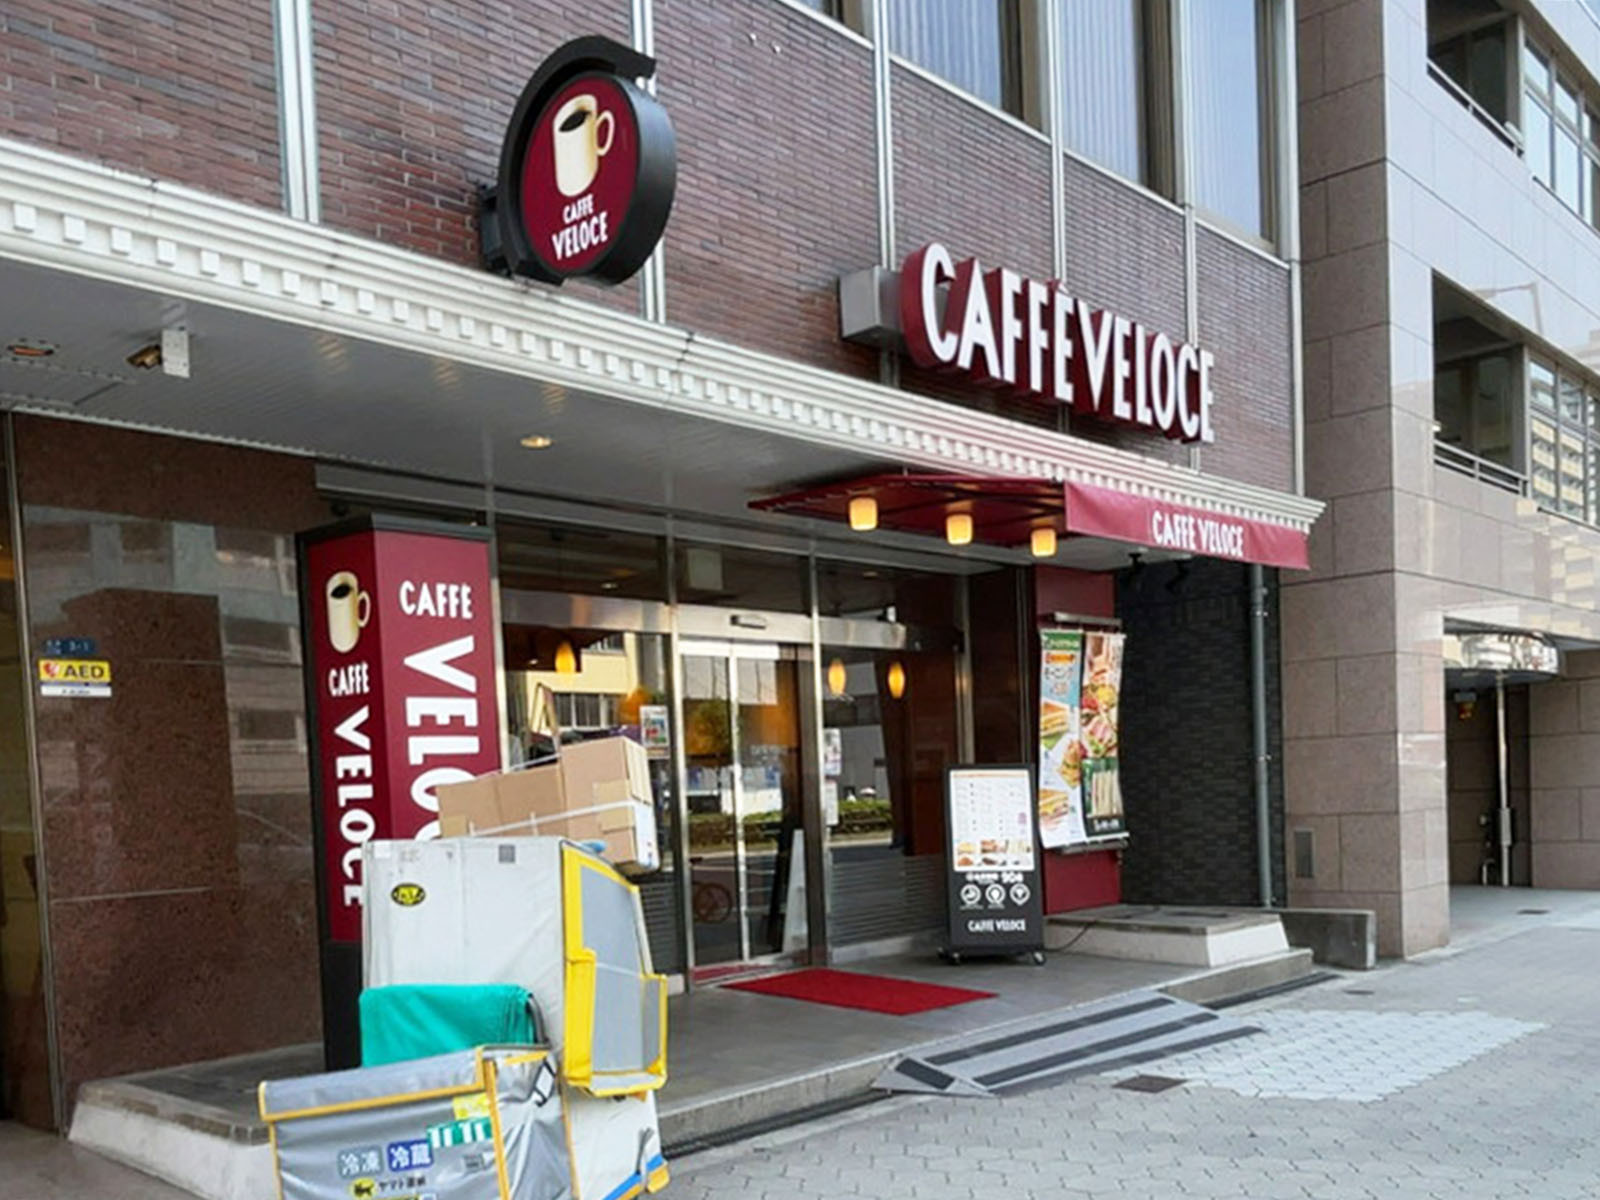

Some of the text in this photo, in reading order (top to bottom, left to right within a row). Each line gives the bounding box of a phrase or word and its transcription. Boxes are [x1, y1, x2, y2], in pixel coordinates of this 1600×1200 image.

[552, 211, 609, 261] VELOCE
[1077, 299, 1215, 444] VELOCE
[1197, 517, 1244, 558] VELOCE
[64, 664, 105, 679] AED
